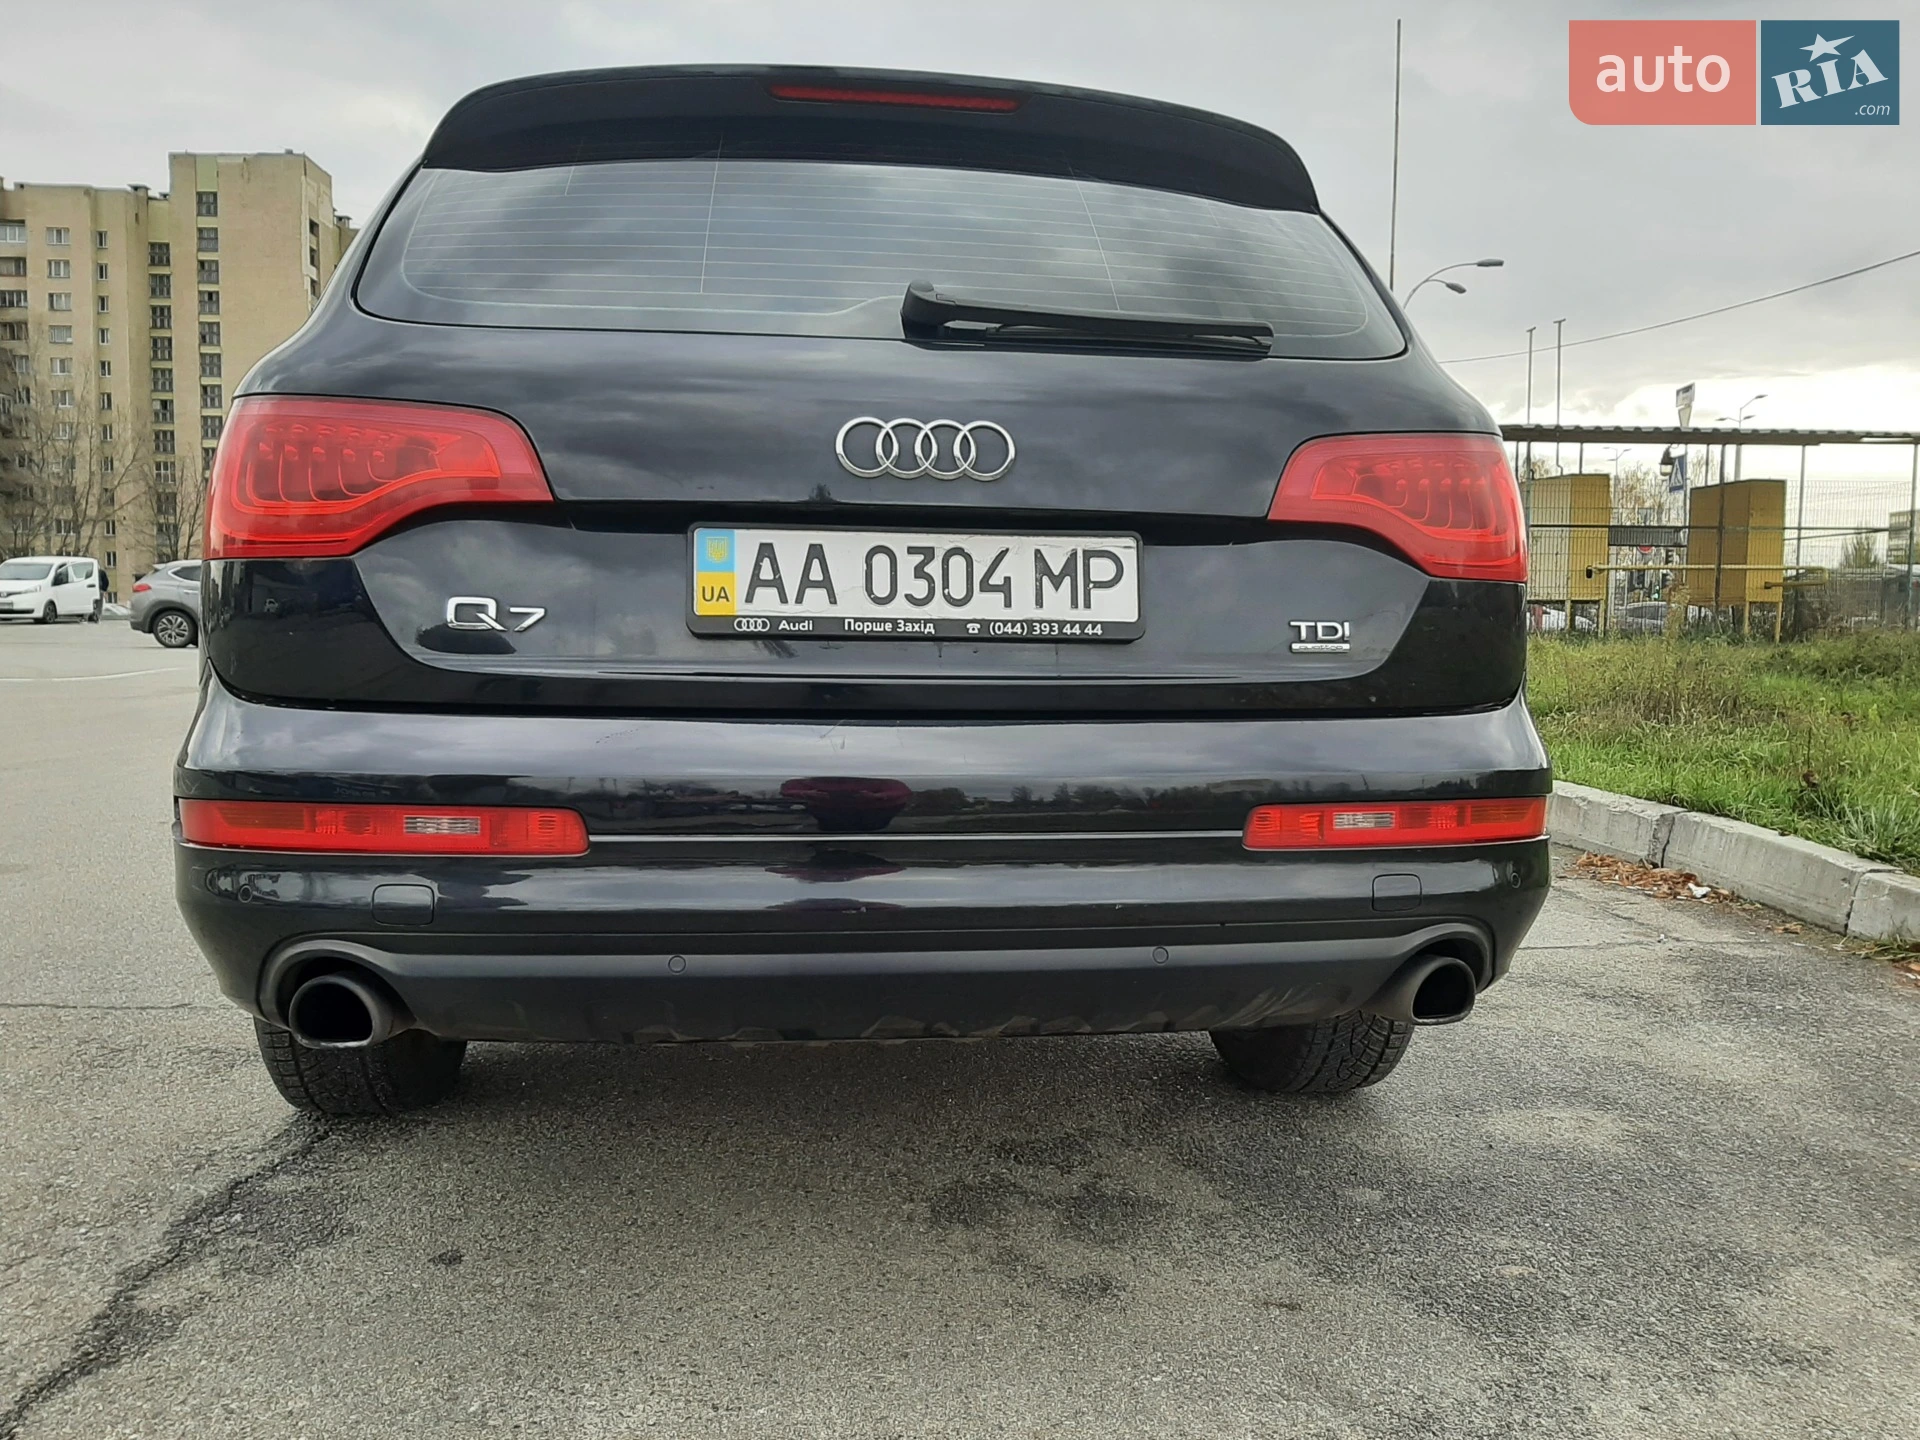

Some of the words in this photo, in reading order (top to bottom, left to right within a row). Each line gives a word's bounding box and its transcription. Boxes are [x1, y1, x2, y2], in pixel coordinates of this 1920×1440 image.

[744, 542, 838, 604] AA
[864, 544, 1012, 609] 0304
[1033, 547, 1124, 609] MP
[701, 585, 730, 602] UA
[446, 596, 545, 631] Q7
[778, 619, 813, 631] Audi
[844, 618, 893, 634] Порше
[896, 619, 935, 635] Захід
[989, 621, 1028, 635] (044)
[1032, 622, 1059, 635] 393
[1062, 623, 1081, 635] 44
[1084, 623, 1103, 635] 44
[1289, 621, 1350, 641] TDI
